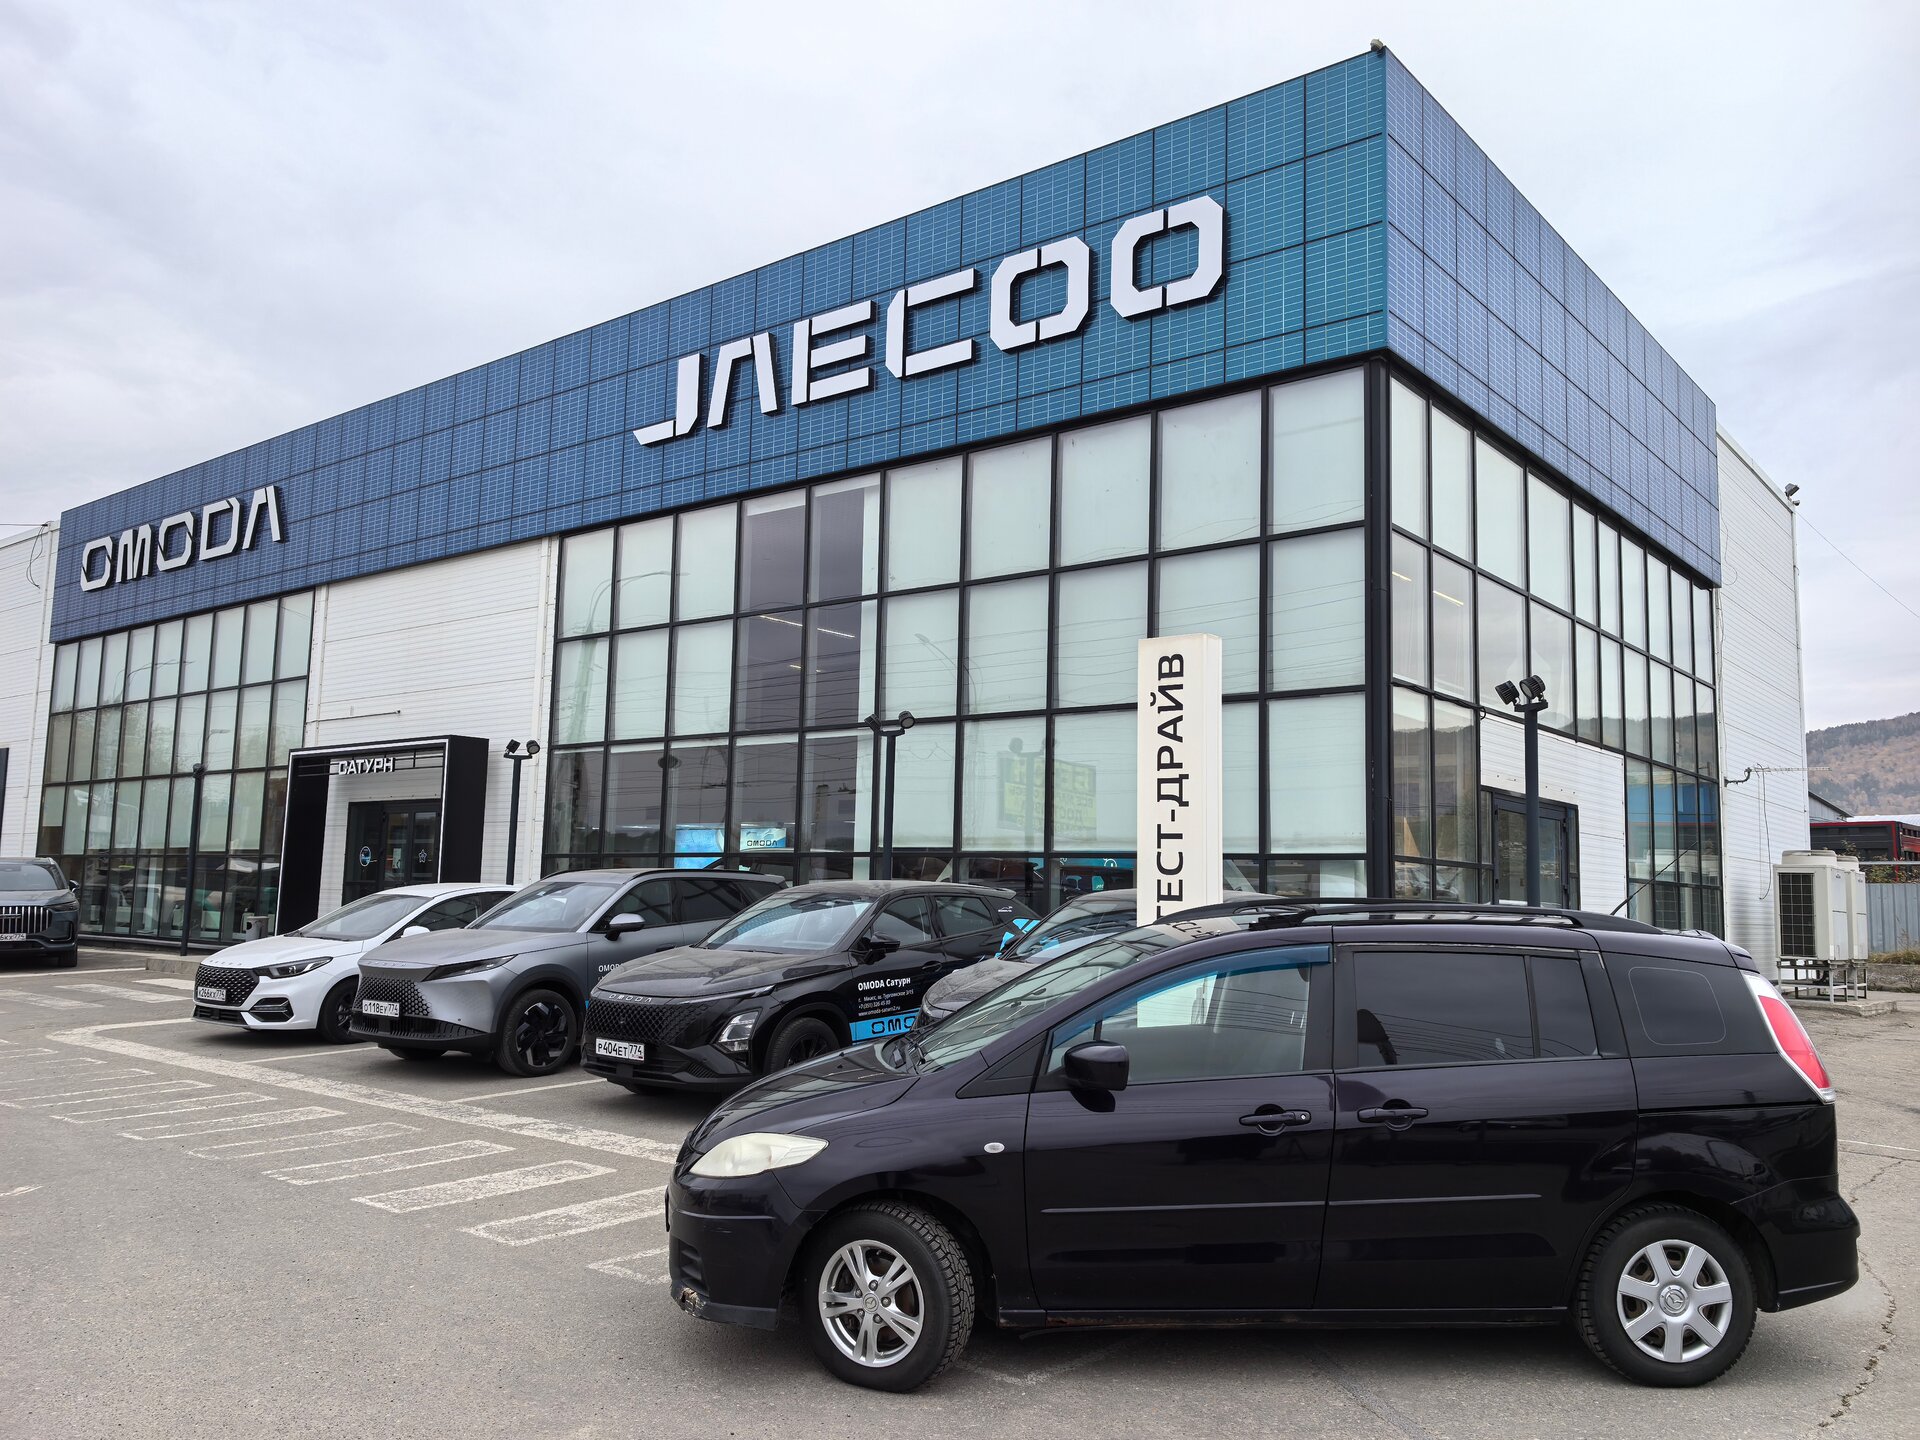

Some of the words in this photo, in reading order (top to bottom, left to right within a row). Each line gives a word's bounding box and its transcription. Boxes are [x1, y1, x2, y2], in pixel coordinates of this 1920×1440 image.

[632, 194, 1225, 447] JAECOO
[79, 484, 283, 593] OMODA
[338, 756, 394, 776] САТУРН
[598, 963, 621, 972] OMOD
[858, 979, 885, 991] OMODA
[886, 977, 911, 987] Сатурн
[608, 993, 653, 1003] OMODA
[388, 1003, 399, 1012] 774
[871, 1016, 917, 1035] OMO
[597, 1042, 628, 1057] Р404ЕТ
[629, 1044, 642, 1056] 774
